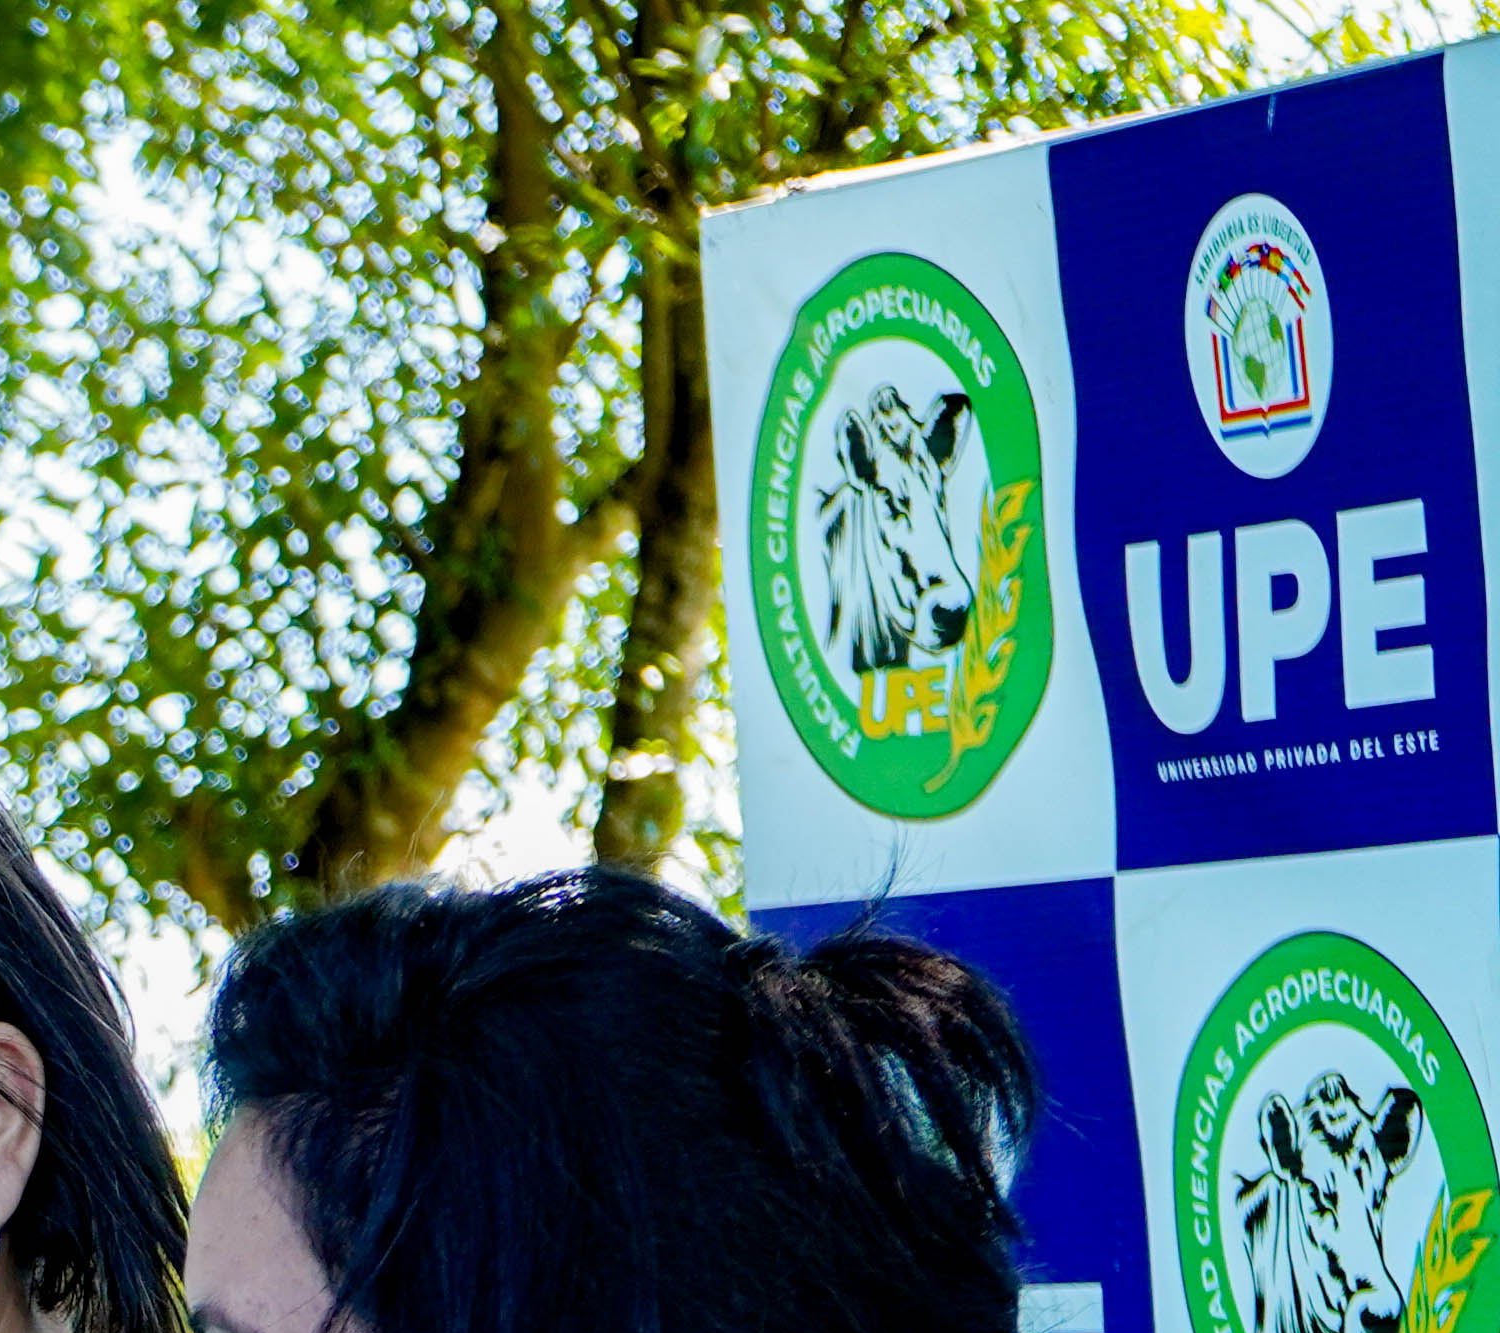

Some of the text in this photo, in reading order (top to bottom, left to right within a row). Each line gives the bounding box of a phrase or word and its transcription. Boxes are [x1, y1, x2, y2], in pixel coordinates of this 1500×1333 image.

[764, 286, 998, 760] FACULTAD CIENCIAS AGROPECUARIAS
[1124, 498, 1435, 735] UPE
[858, 666, 948, 740] UPE
[1157, 730, 1441, 784] UNIVERSIDAD PRIVADA DEL ESTE
[1192, 1064, 1235, 1246] CIENCIAS
[1234, 966, 1439, 1087] AGROPECUARIAS
